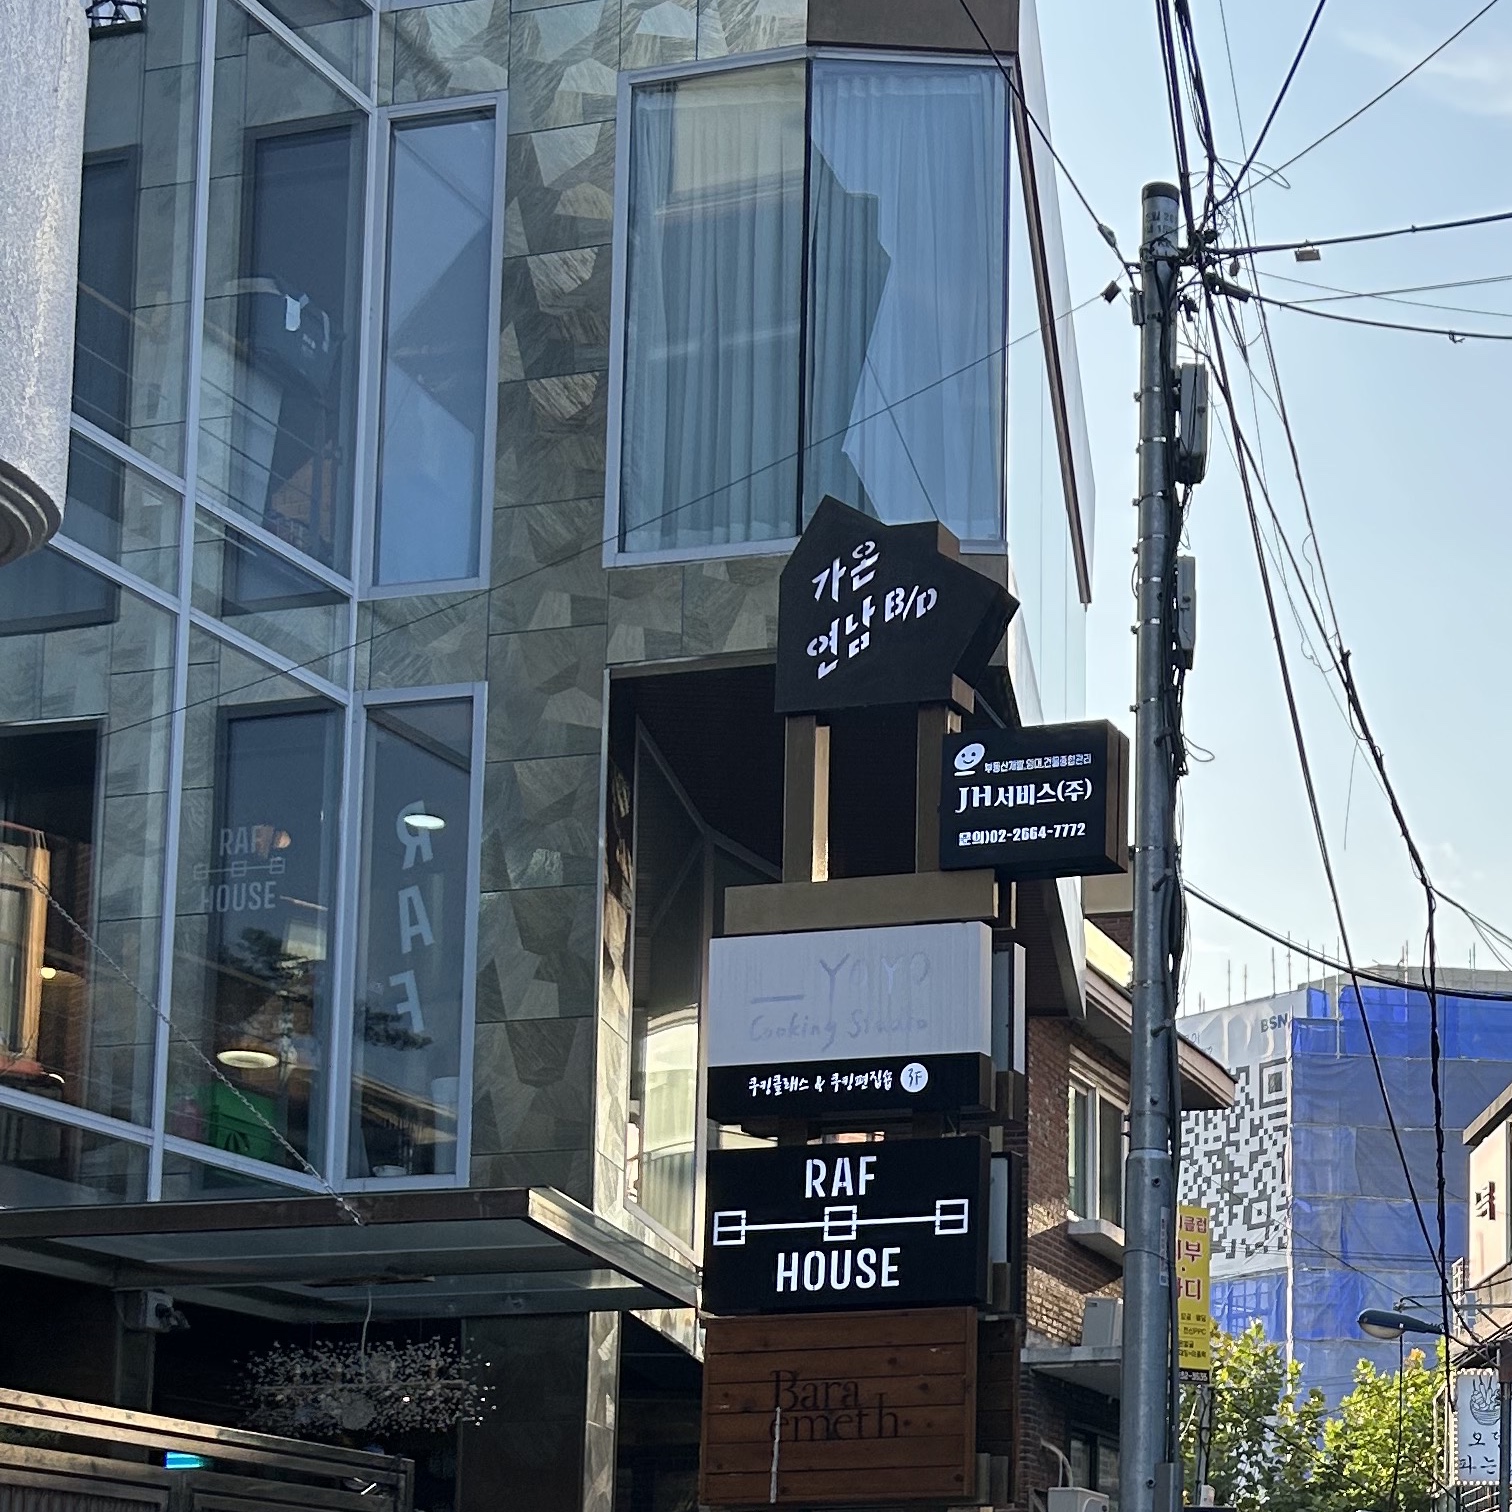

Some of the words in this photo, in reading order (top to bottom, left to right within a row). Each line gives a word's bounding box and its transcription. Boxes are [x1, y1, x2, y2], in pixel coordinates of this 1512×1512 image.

[811, 540, 880, 603] 가온
[806, 595, 876, 680] 연남
[884, 585, 938, 623] B/D
[219, 825, 272, 857] RAF
[200, 880, 277, 914] HOUSE
[804, 1155, 878, 1199] RAF
[775, 1246, 902, 1293] HOUSE
[769, 1369, 862, 1412] Bara
[769, 1392, 899, 1441] emeth
